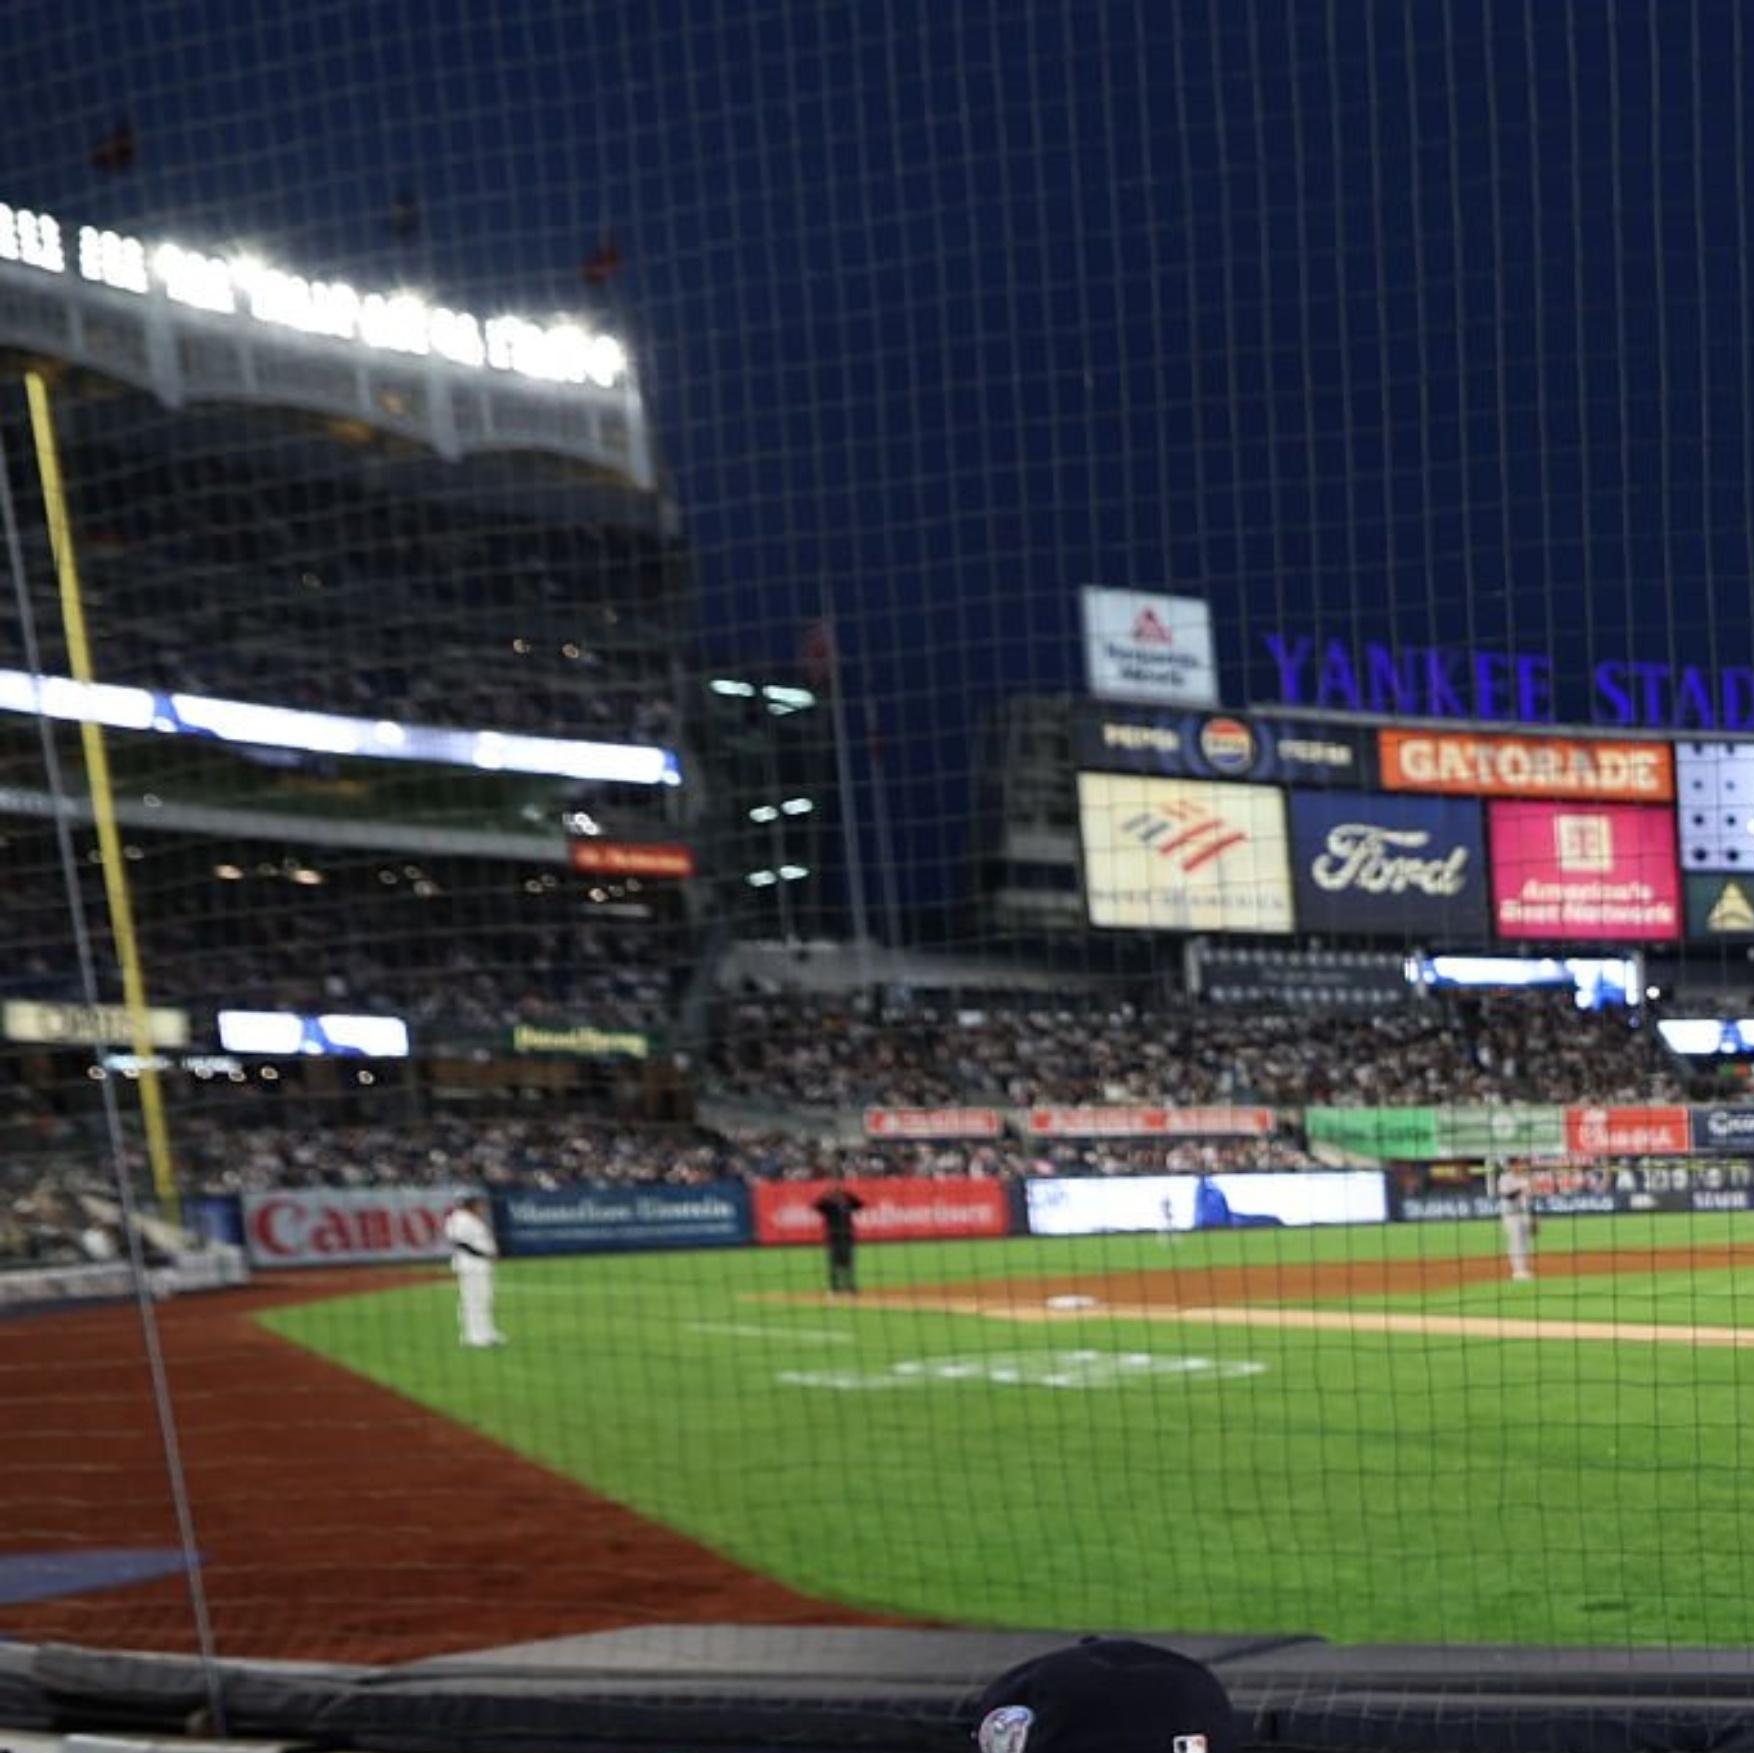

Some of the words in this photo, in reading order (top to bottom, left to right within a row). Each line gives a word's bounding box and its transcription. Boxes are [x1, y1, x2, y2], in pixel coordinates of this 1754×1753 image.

[1264, 633, 1553, 723] YANKEE
[1400, 738, 1659, 791] GATORADE
[1312, 822, 1469, 896] Ford
[254, 1196, 452, 1257] Cano
